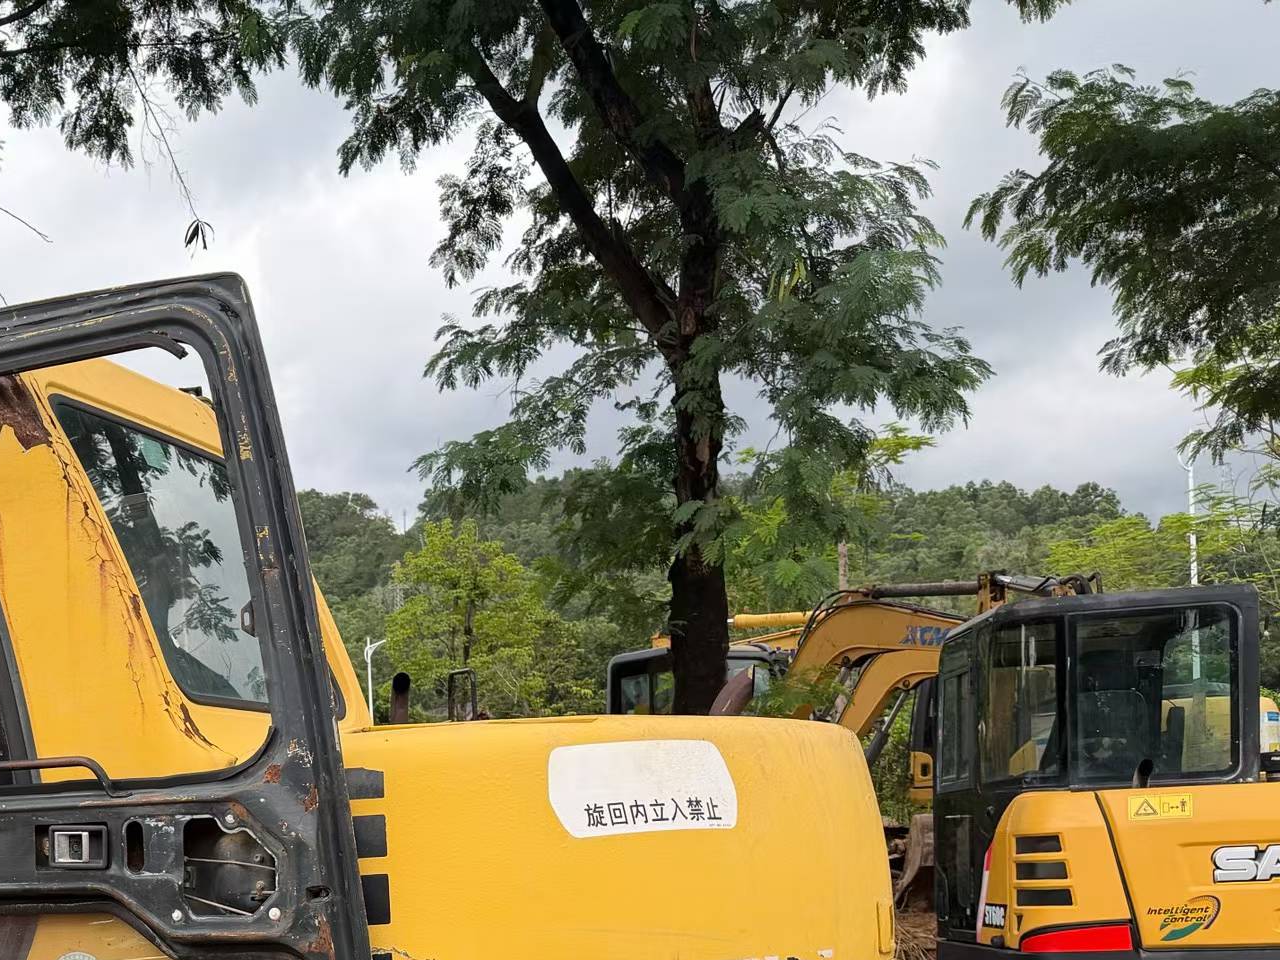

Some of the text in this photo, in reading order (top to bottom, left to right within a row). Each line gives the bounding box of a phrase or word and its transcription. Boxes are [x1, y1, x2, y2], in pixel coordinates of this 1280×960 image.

[583, 796, 723, 828] 旋回内立入禁止
[1147, 904, 1211, 917] Intelligent
